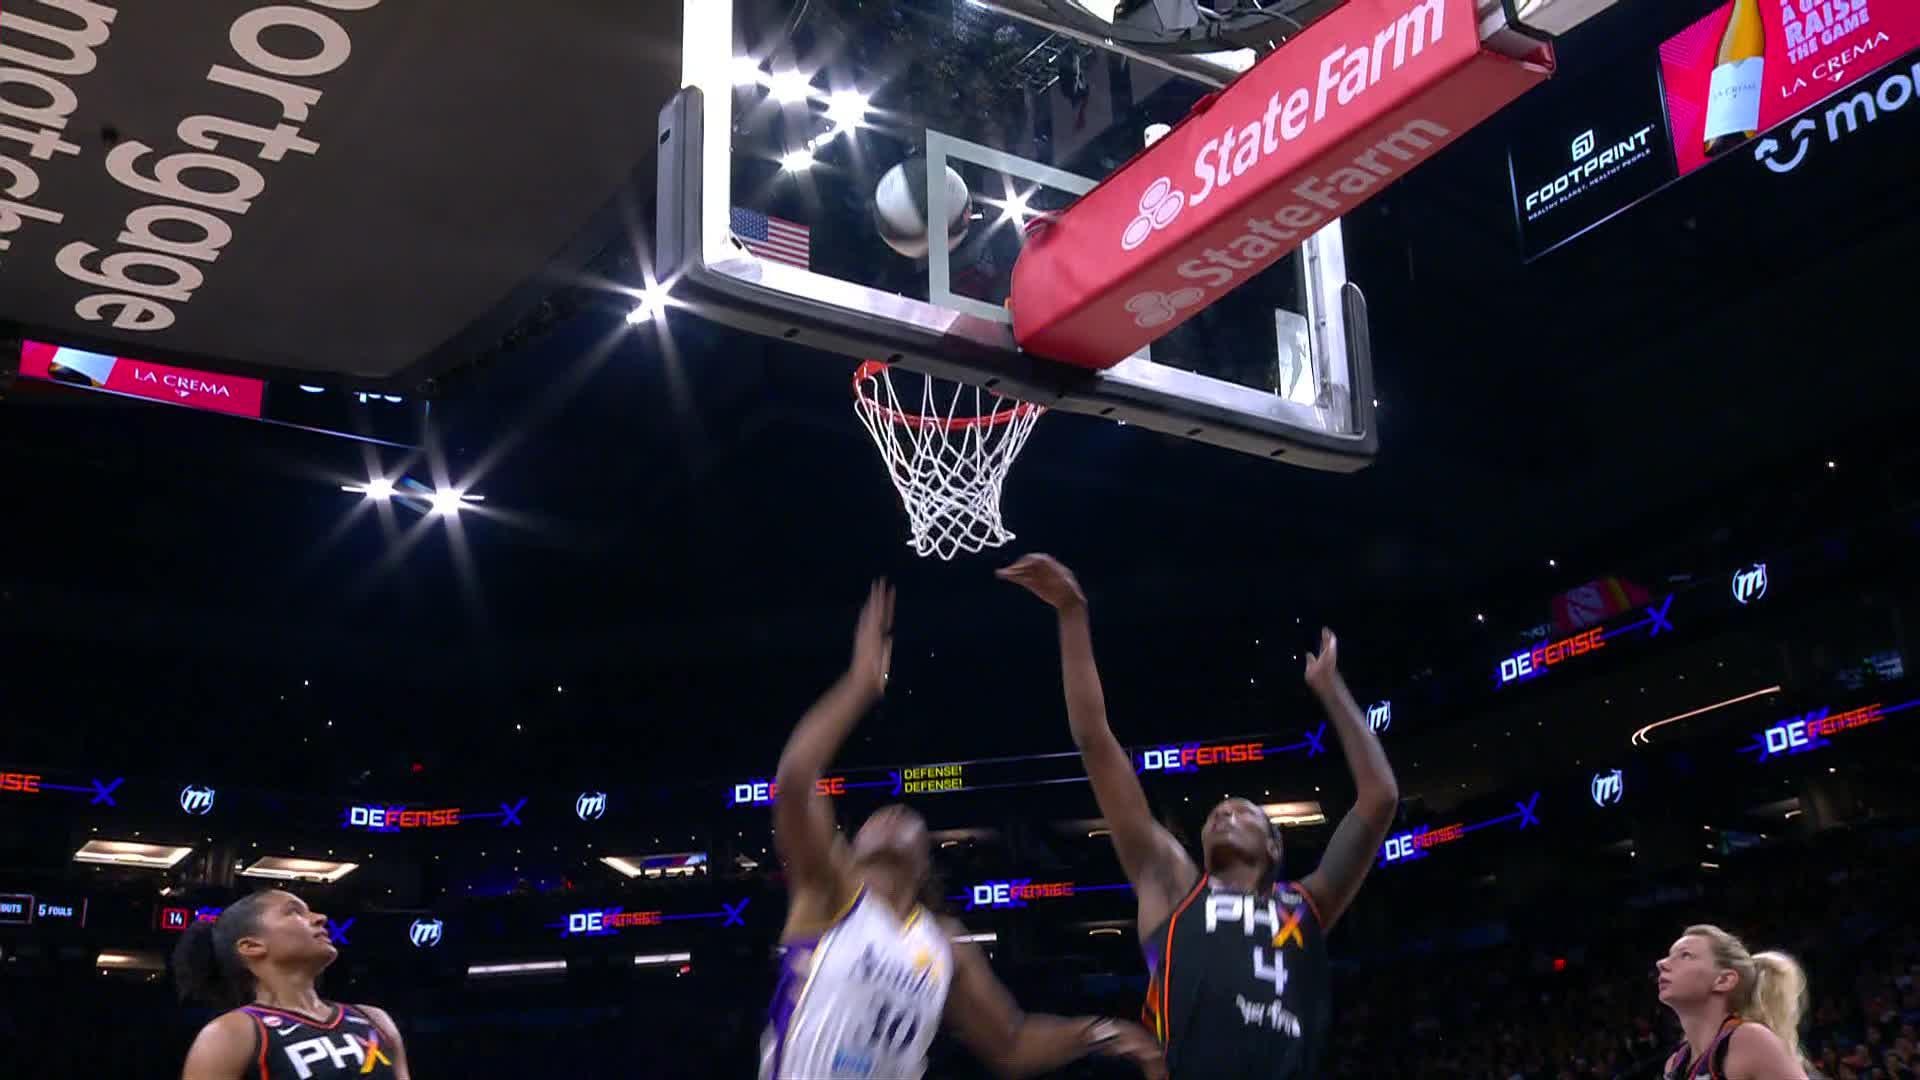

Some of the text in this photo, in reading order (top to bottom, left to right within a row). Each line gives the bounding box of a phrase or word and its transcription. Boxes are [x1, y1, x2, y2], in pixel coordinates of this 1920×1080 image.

[1787, 8, 1870, 65] THE GAME
[1782, 31, 1889, 98] LA CREMA
[56, 0, 380, 331] ortgage
[1525, 126, 1650, 211] FOOTPRINT
[134, 367, 230, 398] LA CREMA
[904, 765, 962, 780] DEFENSE!
[1143, 742, 1265, 770] DEFENSE
[904, 778, 962, 793] DEFENSE!
[351, 806, 461, 827] DEFENSE
[38, 903, 73, 917] 5 FOULS
[169, 912, 183, 925] 14
[1206, 893, 1304, 948] PHX
[1253, 946, 1288, 996] 4
[284, 1030, 392, 1080] PHX
